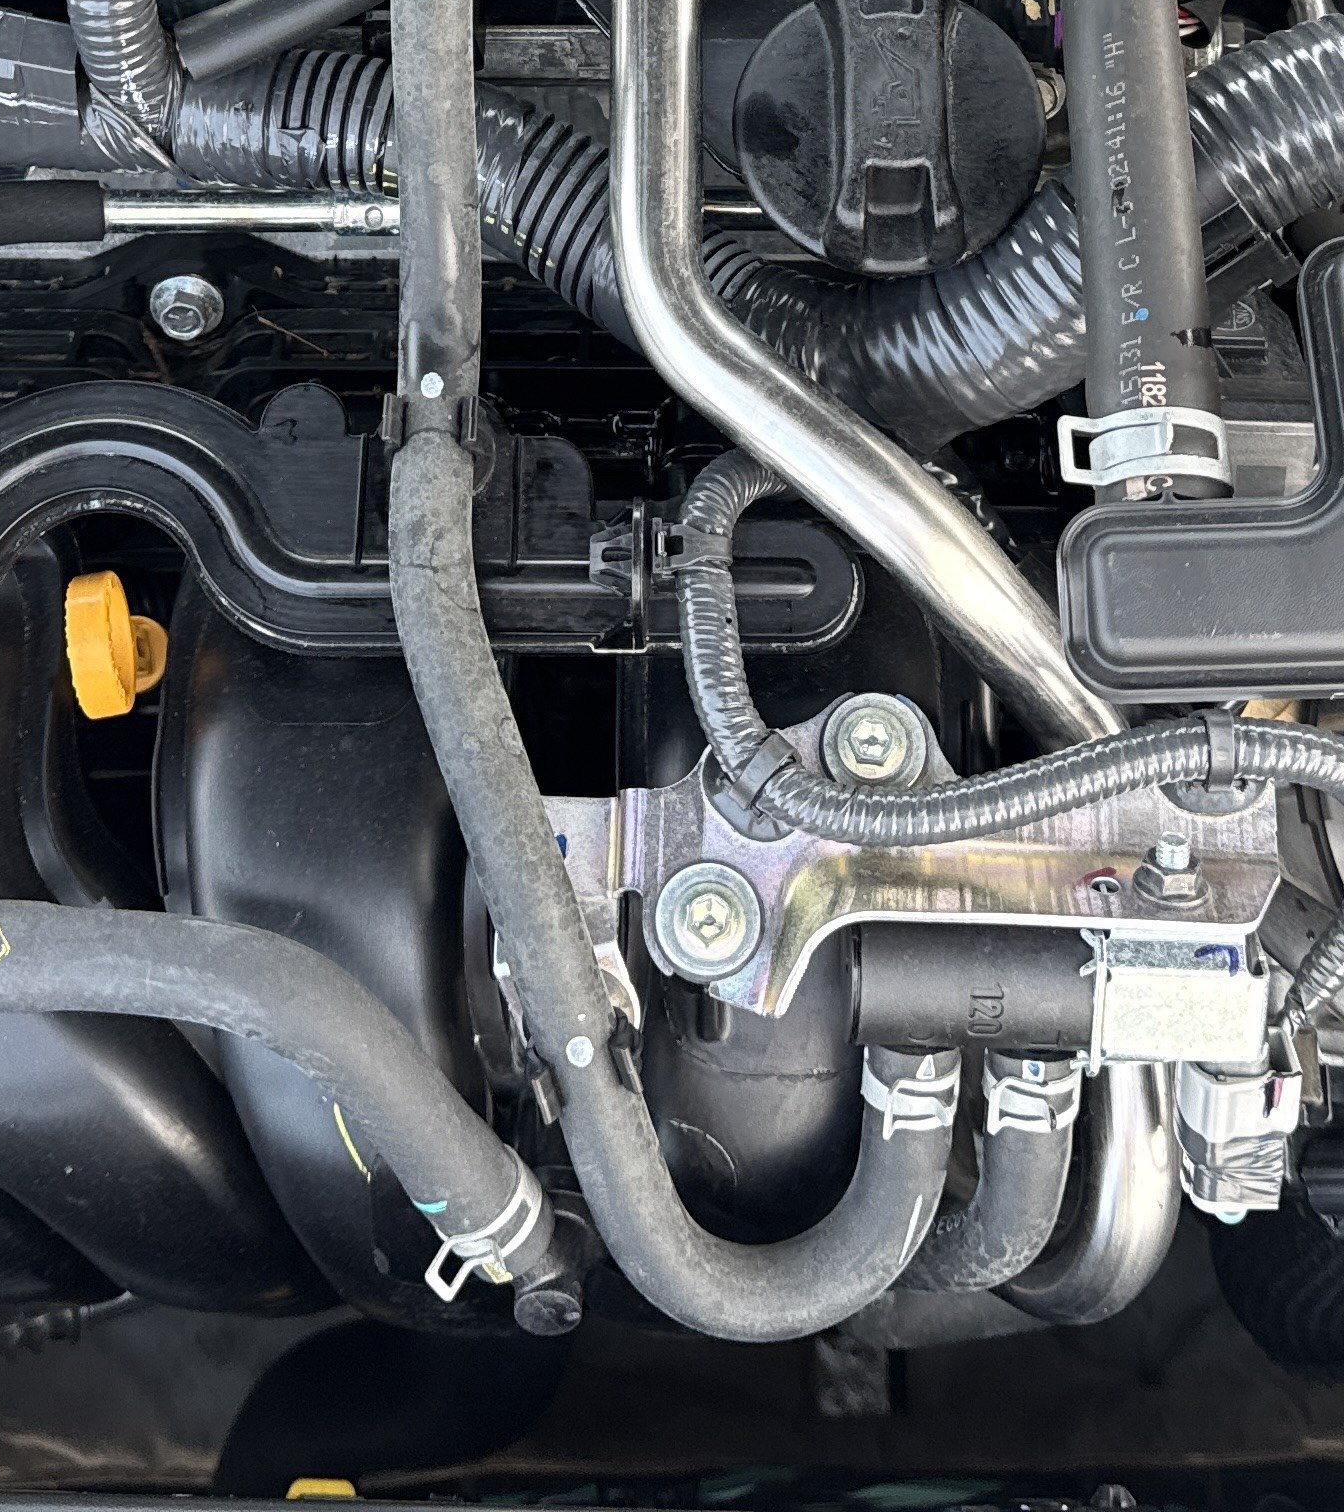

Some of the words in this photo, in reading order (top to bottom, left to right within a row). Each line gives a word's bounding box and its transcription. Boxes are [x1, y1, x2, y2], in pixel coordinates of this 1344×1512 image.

[1105, 81, 1132, 191] 02:41:16
[1118, 254, 1140, 271] C
[1119, 335, 1142, 405] 15131
[967, 982, 1004, 1036] 120
